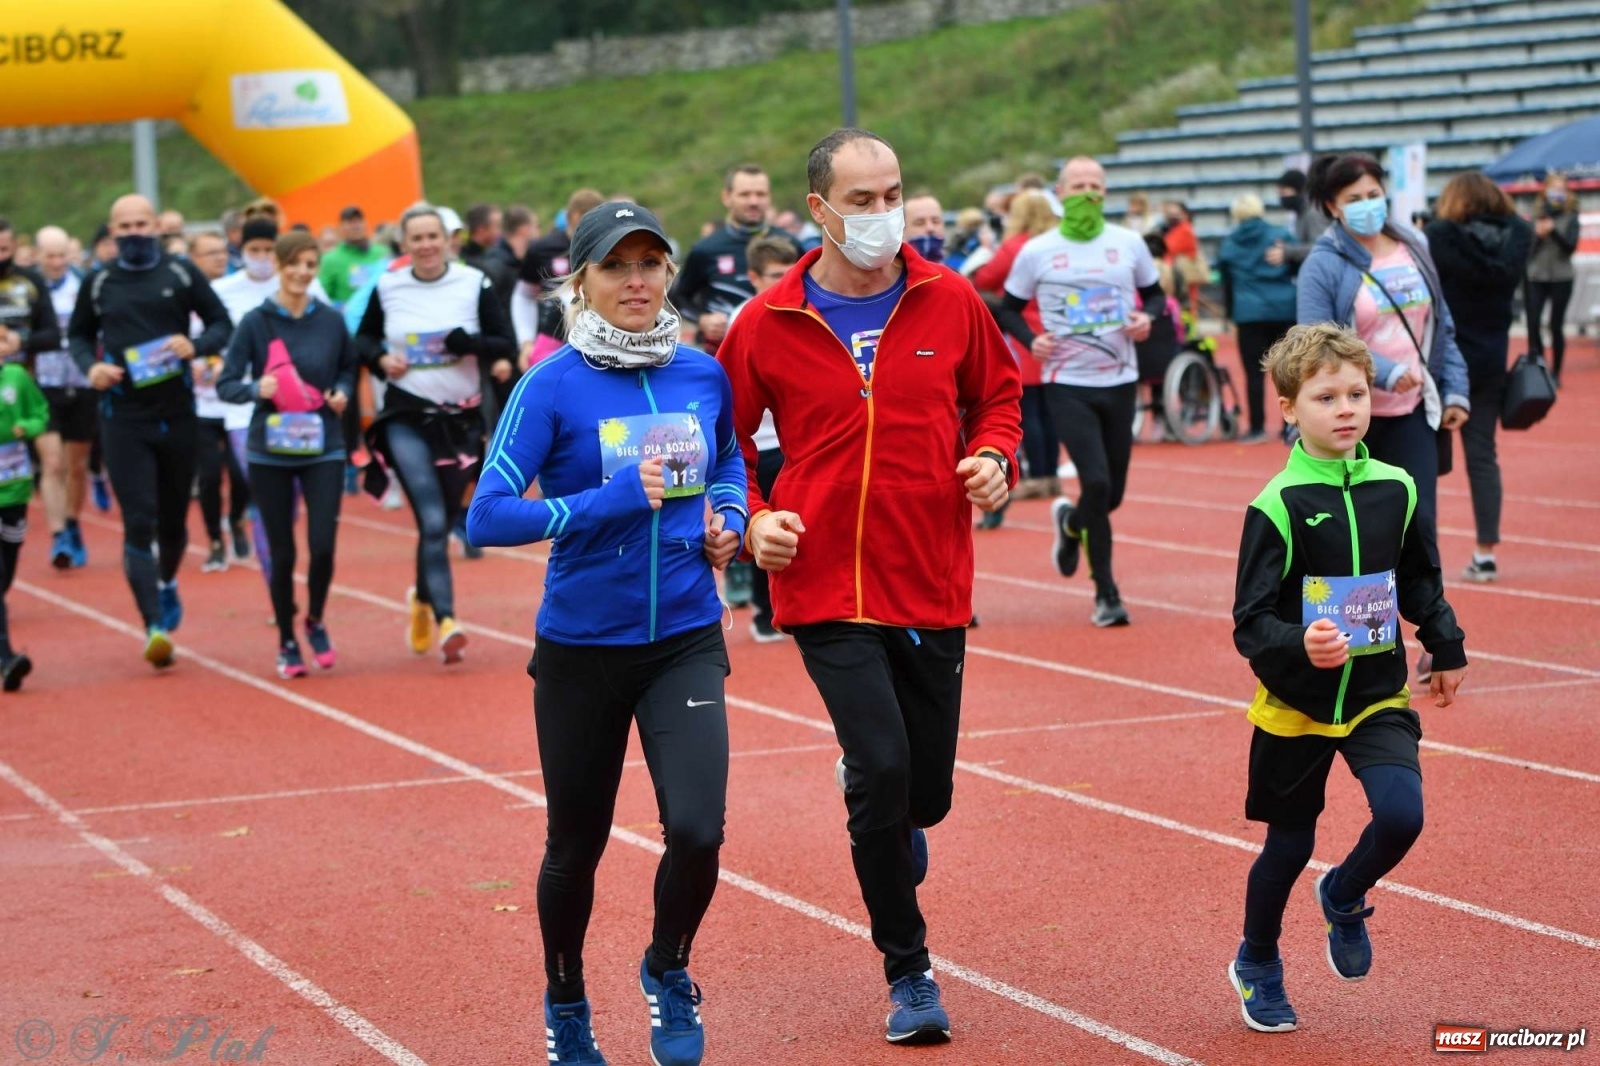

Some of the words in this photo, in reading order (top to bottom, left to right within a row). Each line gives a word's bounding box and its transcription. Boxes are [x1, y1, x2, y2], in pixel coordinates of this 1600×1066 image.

[686, 401, 700, 411] 4F
[616, 446, 639, 457] BIEG
[644, 445, 662, 455] DLA
[671, 469, 698, 485] 115
[1317, 605, 1339, 614] BIEG
[1345, 604, 1363, 614] DLA
[1368, 626, 1391, 642] 051
